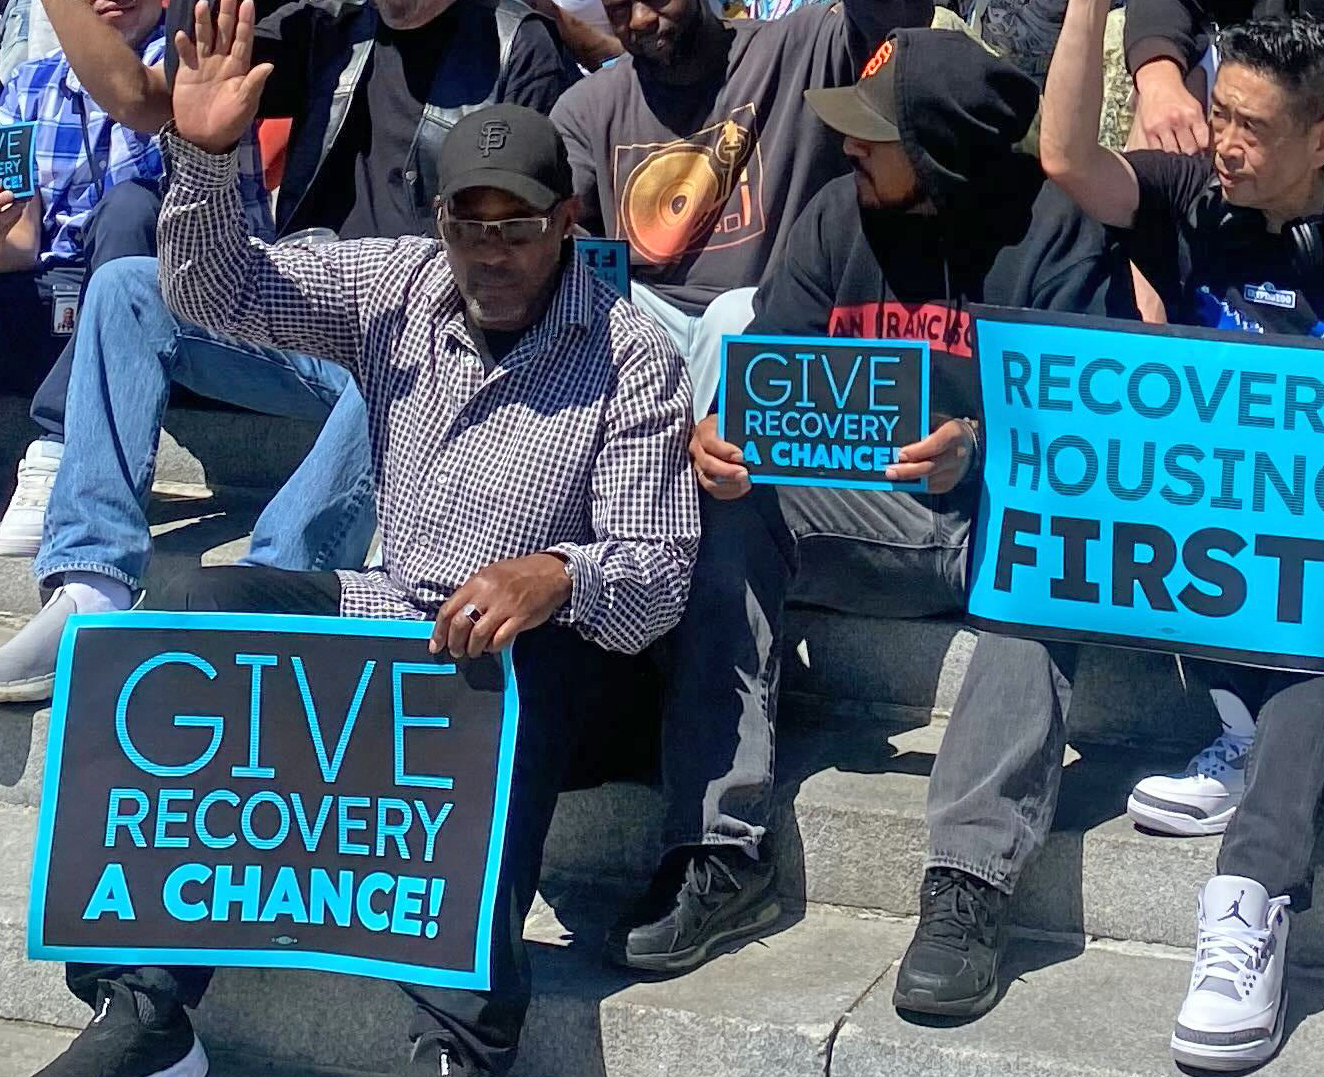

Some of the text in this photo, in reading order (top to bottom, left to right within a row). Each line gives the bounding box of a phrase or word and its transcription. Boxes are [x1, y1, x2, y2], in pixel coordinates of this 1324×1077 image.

[745, 353, 901, 412] GIVE
[743, 441, 762, 466] A
[745, 410, 900, 442] RECOVERY
[116, 651, 457, 789] GIVE
[104, 788, 454, 862] RECOVERY
[83, 863, 446, 939] A CHANCE!
